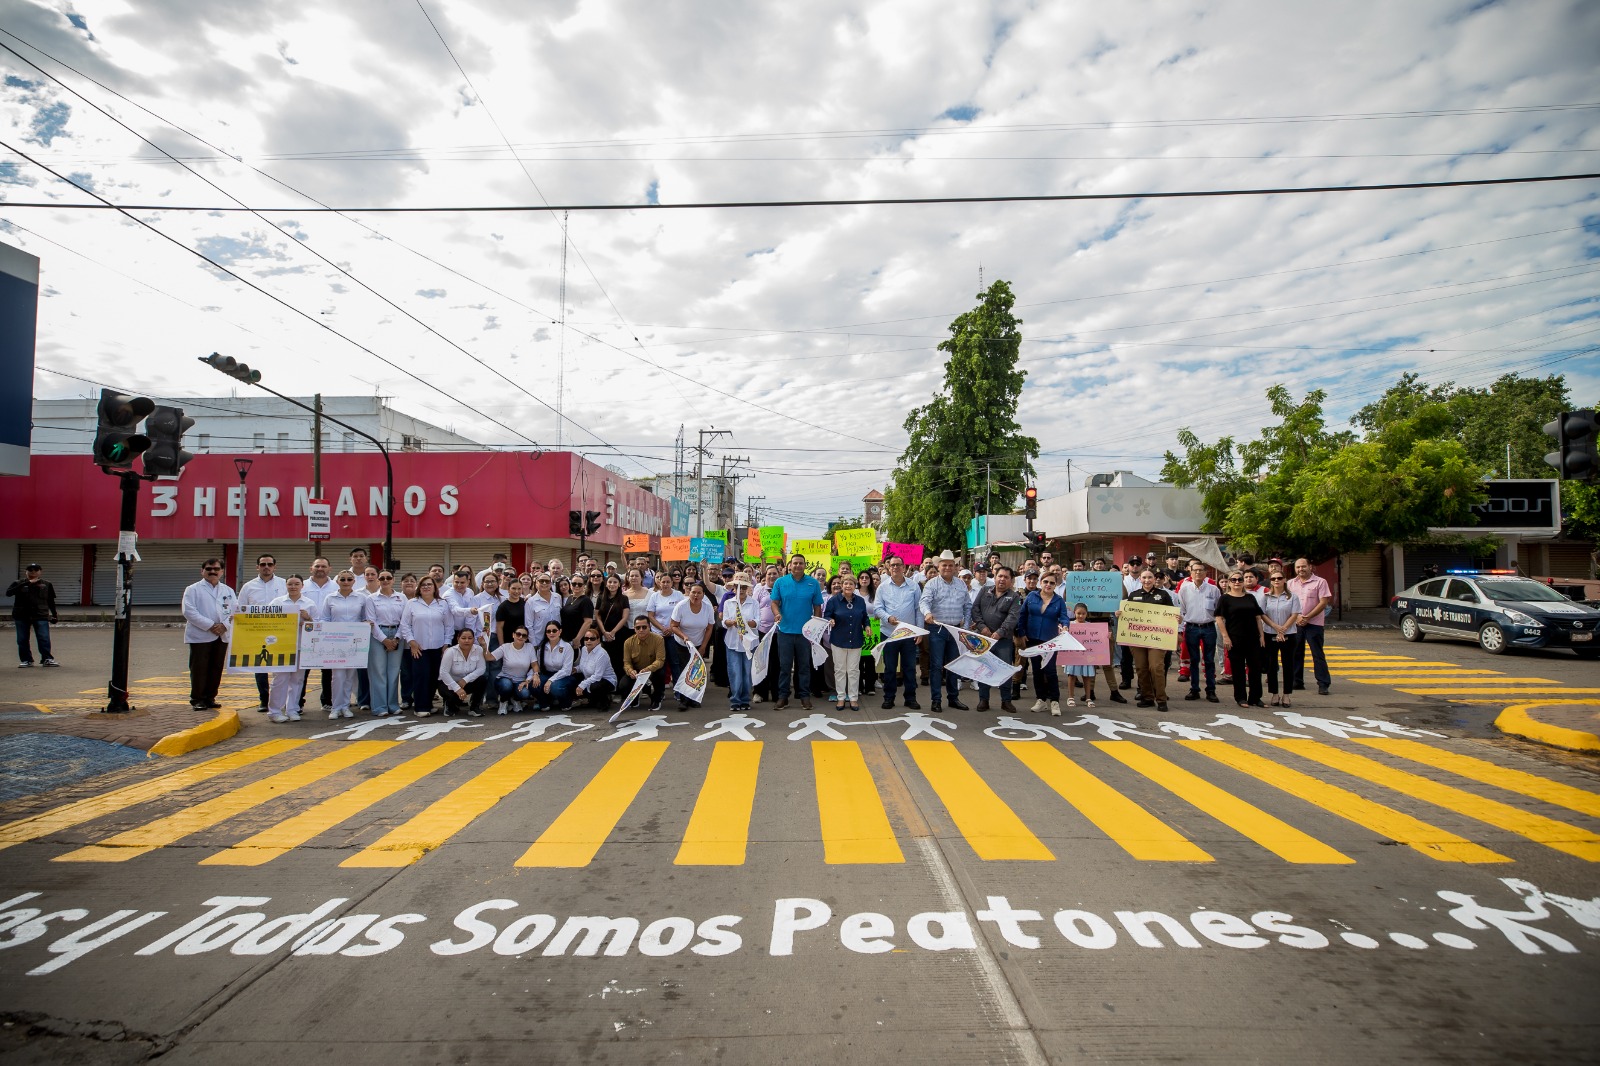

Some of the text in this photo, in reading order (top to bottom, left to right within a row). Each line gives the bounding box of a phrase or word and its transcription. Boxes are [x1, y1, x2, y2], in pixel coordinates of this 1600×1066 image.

[150, 484, 460, 517] 3 HERMANOS
[250, 605, 261, 614] DEL
[1442, 611, 1449, 621] DE
[1523, 628, 1541, 636] 0442
[25, 910, 169, 977] y
[134, 895, 428, 958] Todas
[429, 898, 744, 958] Somos
